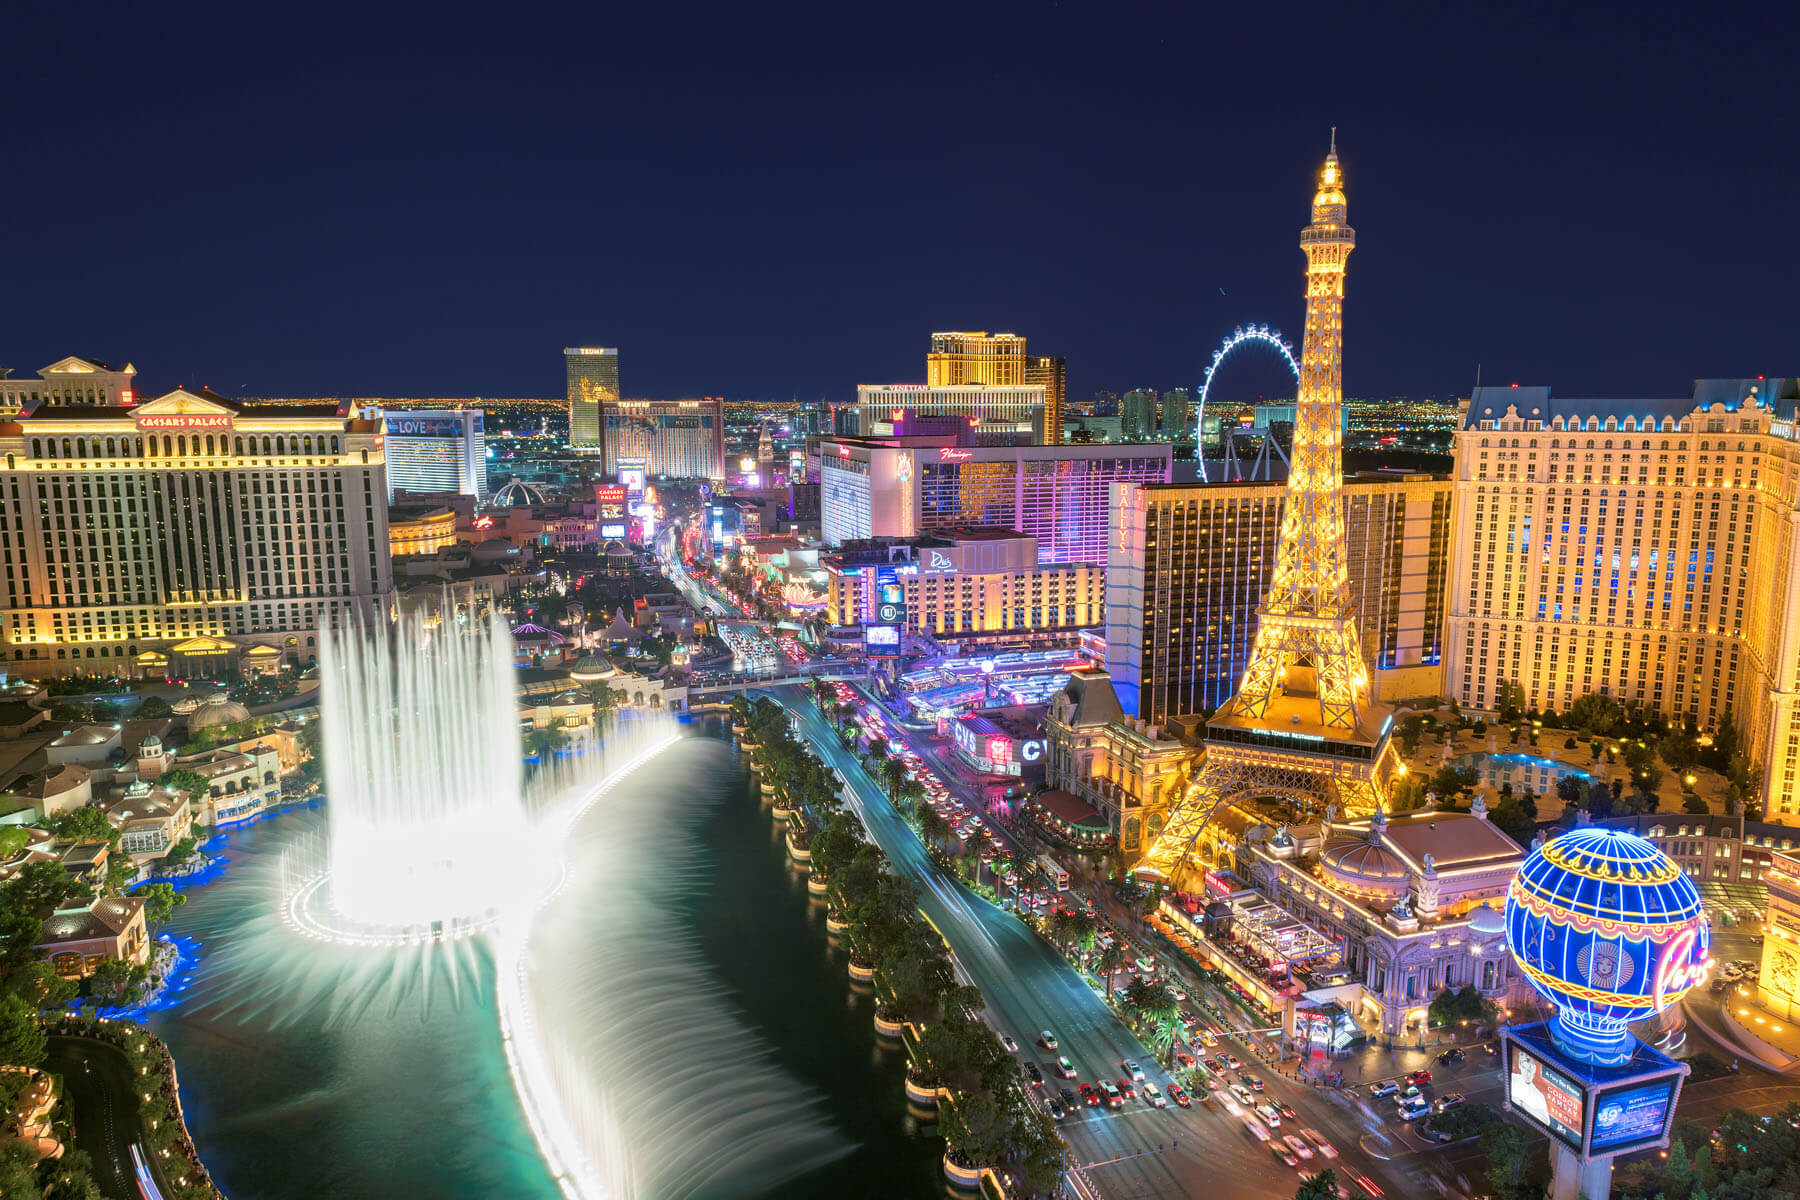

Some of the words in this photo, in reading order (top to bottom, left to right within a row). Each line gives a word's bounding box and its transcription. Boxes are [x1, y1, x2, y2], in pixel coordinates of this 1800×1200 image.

[139, 417, 186, 427] CAESARS
[188, 417, 228, 426] PALACE
[399, 421, 427, 434] LOVE
[955, 722, 977, 753] CVS
[1656, 929, 1716, 1013] Paris
